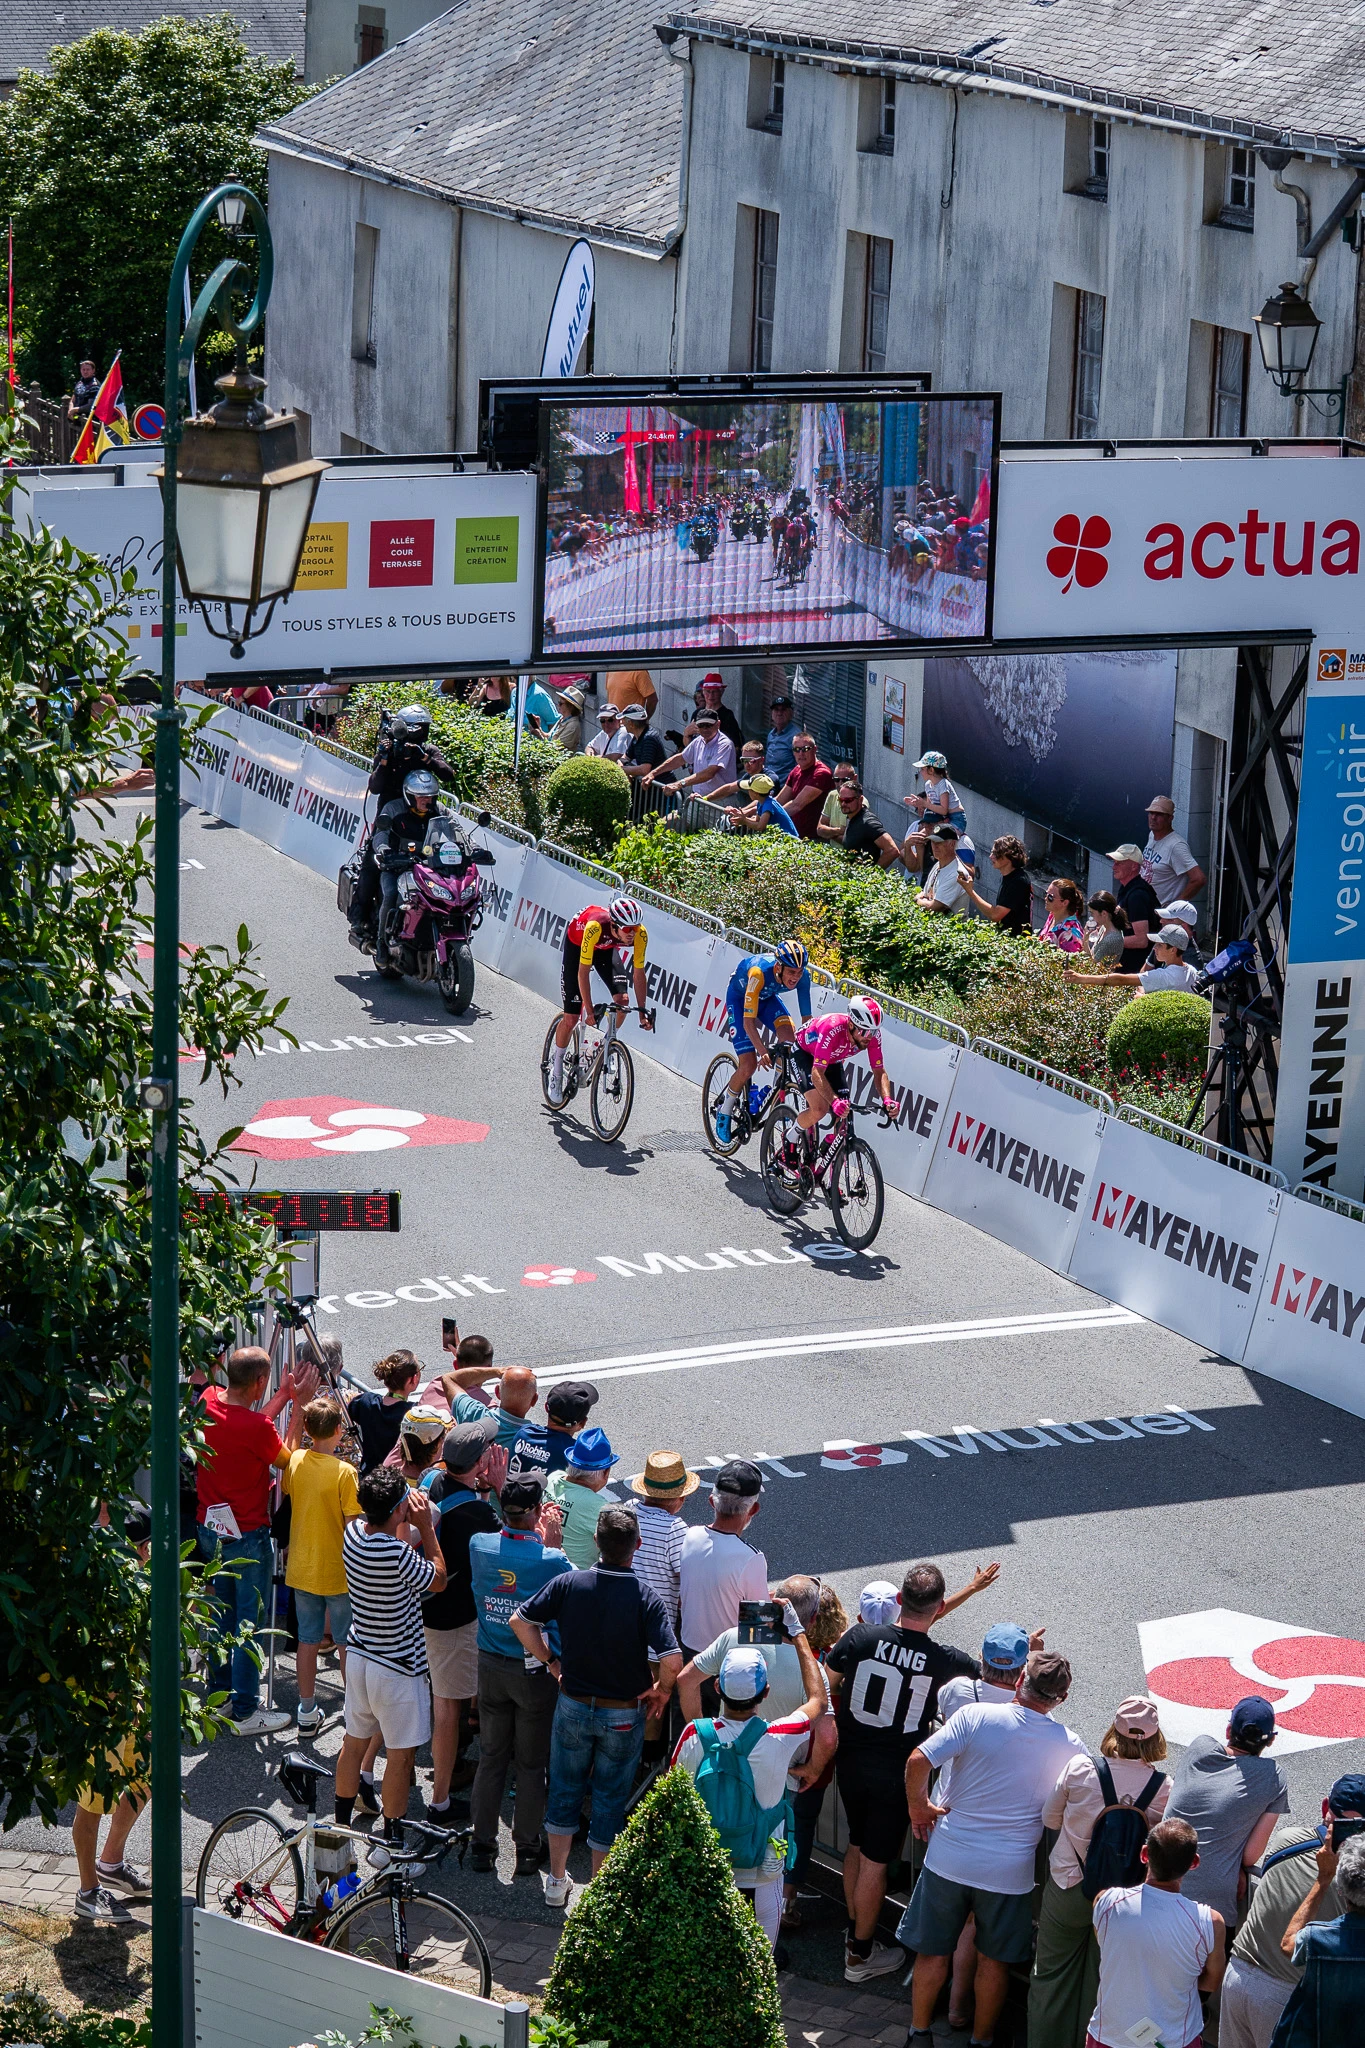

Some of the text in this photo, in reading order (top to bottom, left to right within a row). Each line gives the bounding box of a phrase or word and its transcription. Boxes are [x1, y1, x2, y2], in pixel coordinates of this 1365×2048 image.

[302, 545, 334, 554] LÔTURE
[304, 534, 333, 542] ORTAIL
[389, 536, 415, 545] ALLÉE
[390, 549, 414, 557] COUR
[465, 545, 509, 554] ENTRETIEN
[473, 534, 501, 542] TAILLE
[1143, 508, 1361, 581] actua
[381, 560, 422, 569] TERRASSE
[466, 556, 507, 565] CRÉATION
[282, 611, 516, 633] TOUS STYLES & TOUS BUDGETS
[231, 755, 295, 809] MAYENNE
[293, 786, 361, 844] MAYENNE
[1334, 723, 1365, 936] vensolair
[1228, 959, 1242, 971] LYNX
[821, 1035, 832, 1050] VAN
[1302, 976, 1352, 1193] AYENNE
[820, 1134, 844, 1169] VAN RYSEL
[947, 1110, 1086, 1213] MAYENNE
[1091, 1181, 1260, 1295] MAYENNE
[316, 1273, 507, 1315] redit
[1270, 1262, 1365, 1345] MAY
[900, 1404, 1217, 1459] Mutuel
[524, 1442, 551, 1458] Robine
[874, 1639, 927, 1672] KING
[849, 1658, 933, 1734] 01
[325, 1878, 376, 1931] lapierre
[391, 1896, 401, 1954] lapierre
